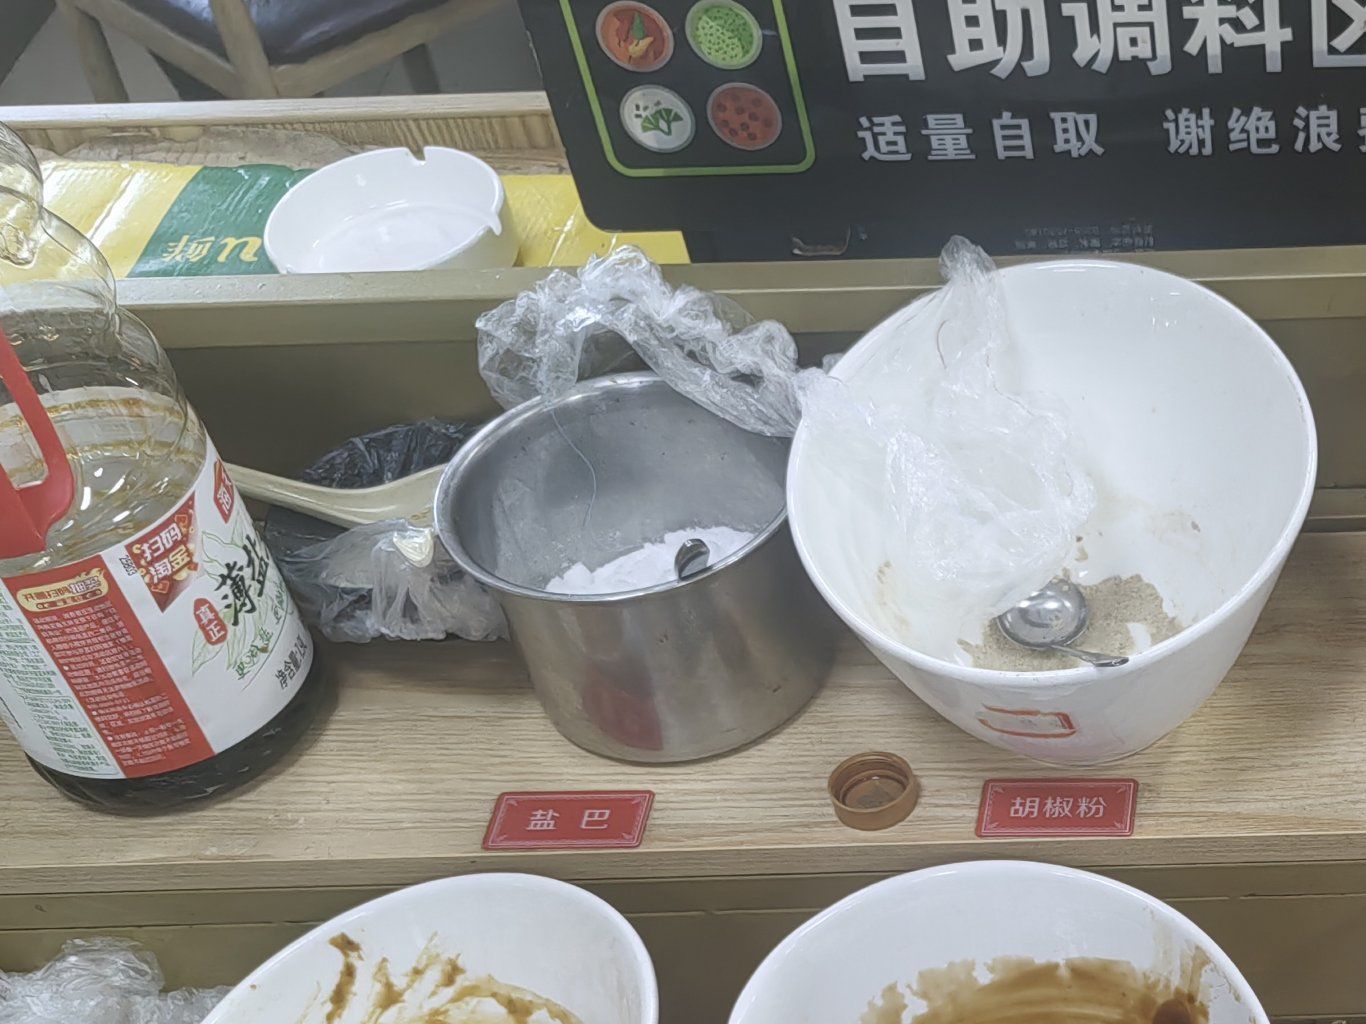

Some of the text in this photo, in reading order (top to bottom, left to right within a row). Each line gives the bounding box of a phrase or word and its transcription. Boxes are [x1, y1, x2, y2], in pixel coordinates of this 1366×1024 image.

[857, 111, 1105, 162] 适量自取
[141, 522, 182, 561] 扫码
[149, 544, 193, 584] 淘金
[196, 604, 226, 642] 真正
[525, 808, 612, 831] 盐巴
[1009, 795, 1108, 820] 胡椒粉
